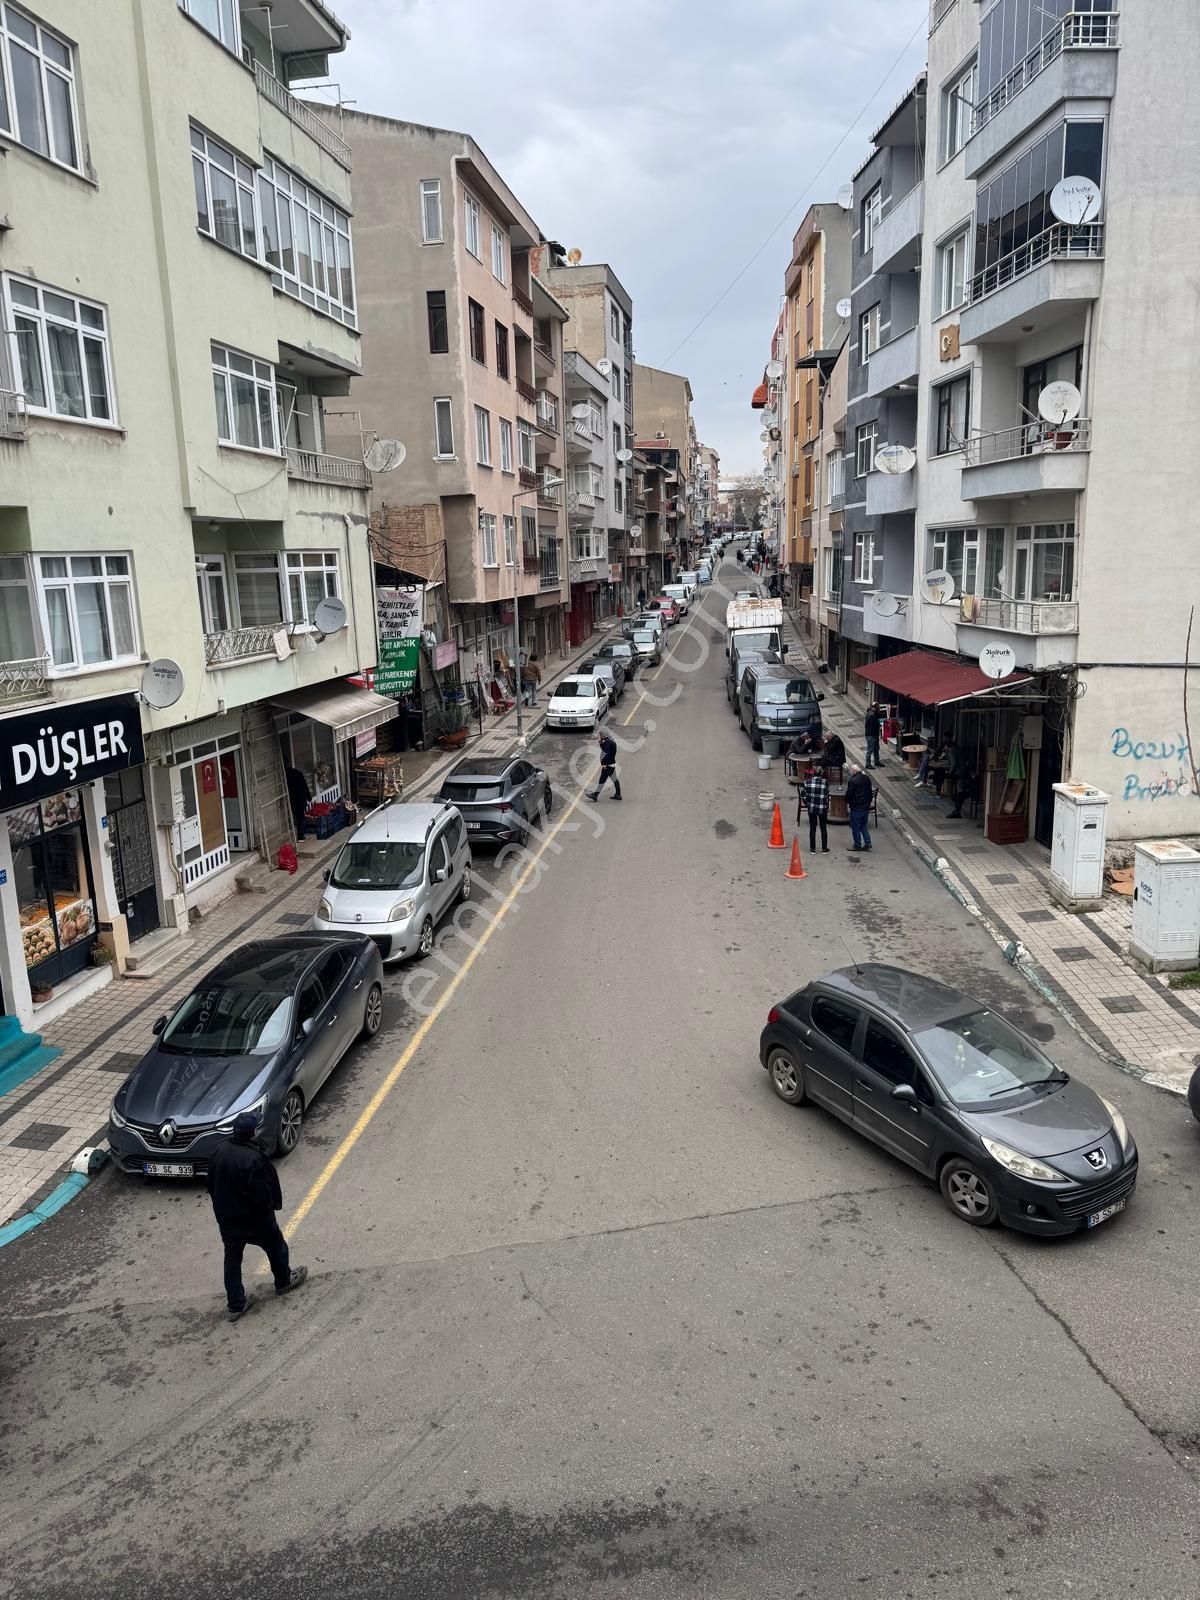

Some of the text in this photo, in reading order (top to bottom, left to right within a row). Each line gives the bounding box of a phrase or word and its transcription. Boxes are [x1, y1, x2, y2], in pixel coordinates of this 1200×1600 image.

[12, 720, 128, 785] DÜŞLER
[147, 1163, 157, 1173] 59
[178, 1166, 192, 1174] 939
